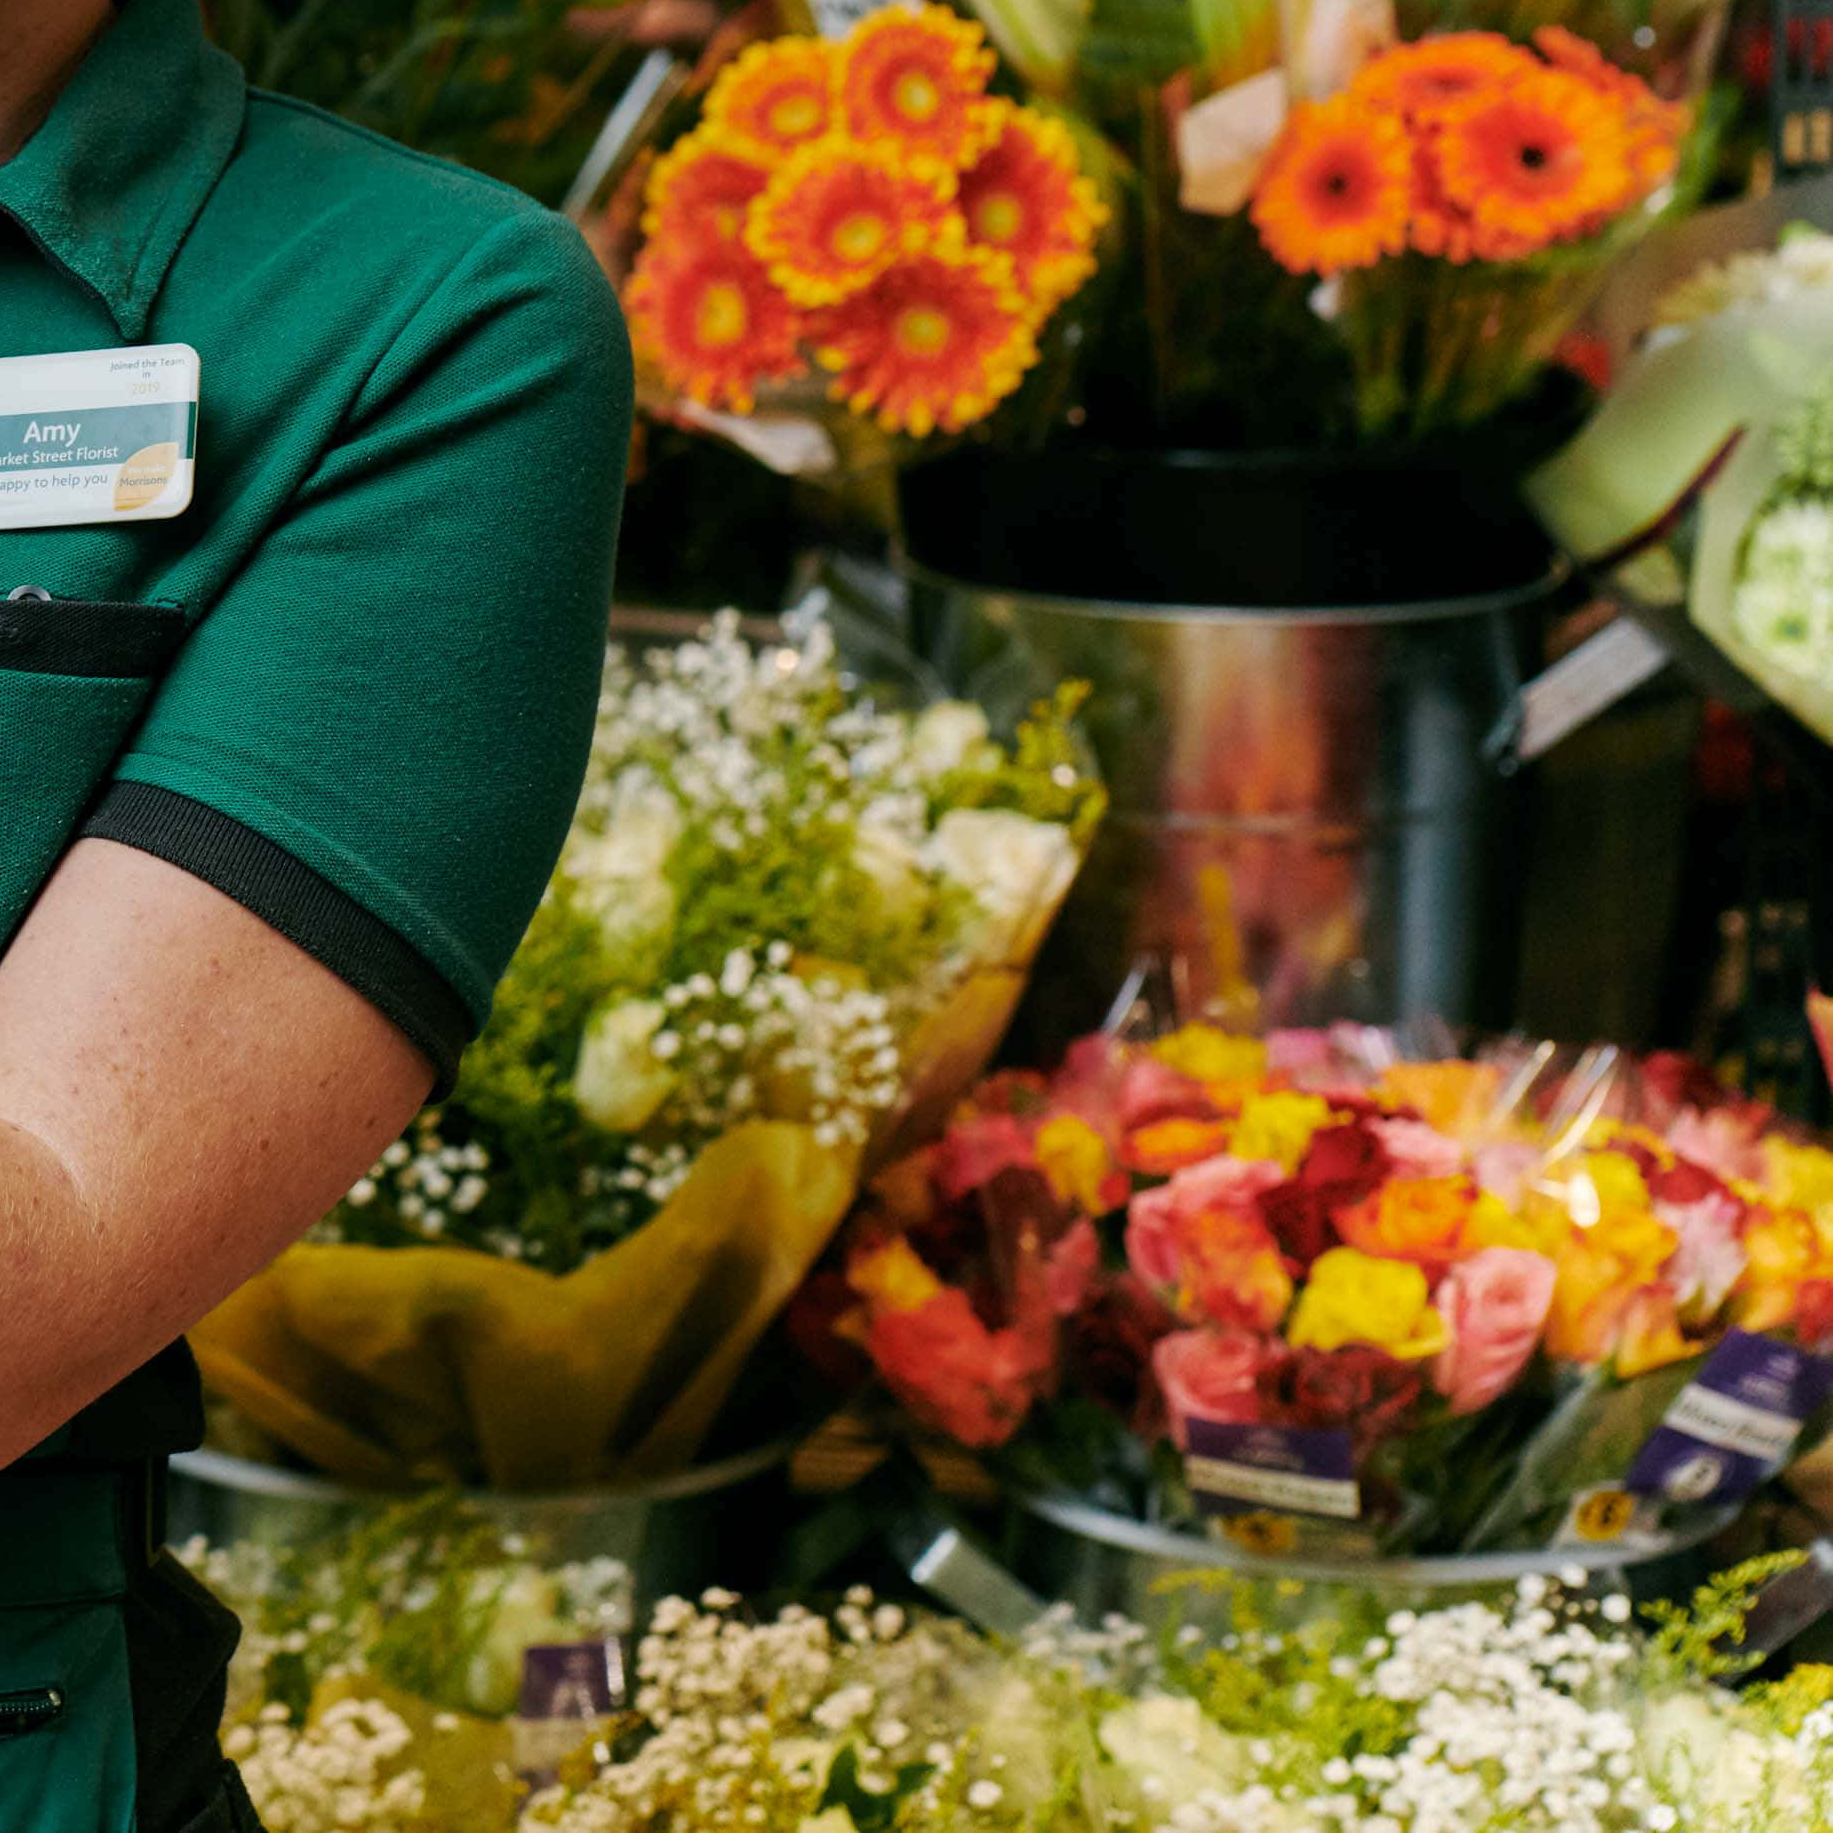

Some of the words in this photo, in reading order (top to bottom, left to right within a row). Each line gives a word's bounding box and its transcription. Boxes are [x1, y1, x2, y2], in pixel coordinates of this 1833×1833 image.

[141, 358, 158, 368] the
[160, 357, 185, 367] Team
[23, 421, 81, 447] Amy
[32, 450, 74, 464] Street
[76, 446, 119, 461] Florist
[34, 478, 48, 488] to
[52, 474, 80, 489] help
[84, 473, 109, 487] you
[119, 474, 167, 487] Morrisons
